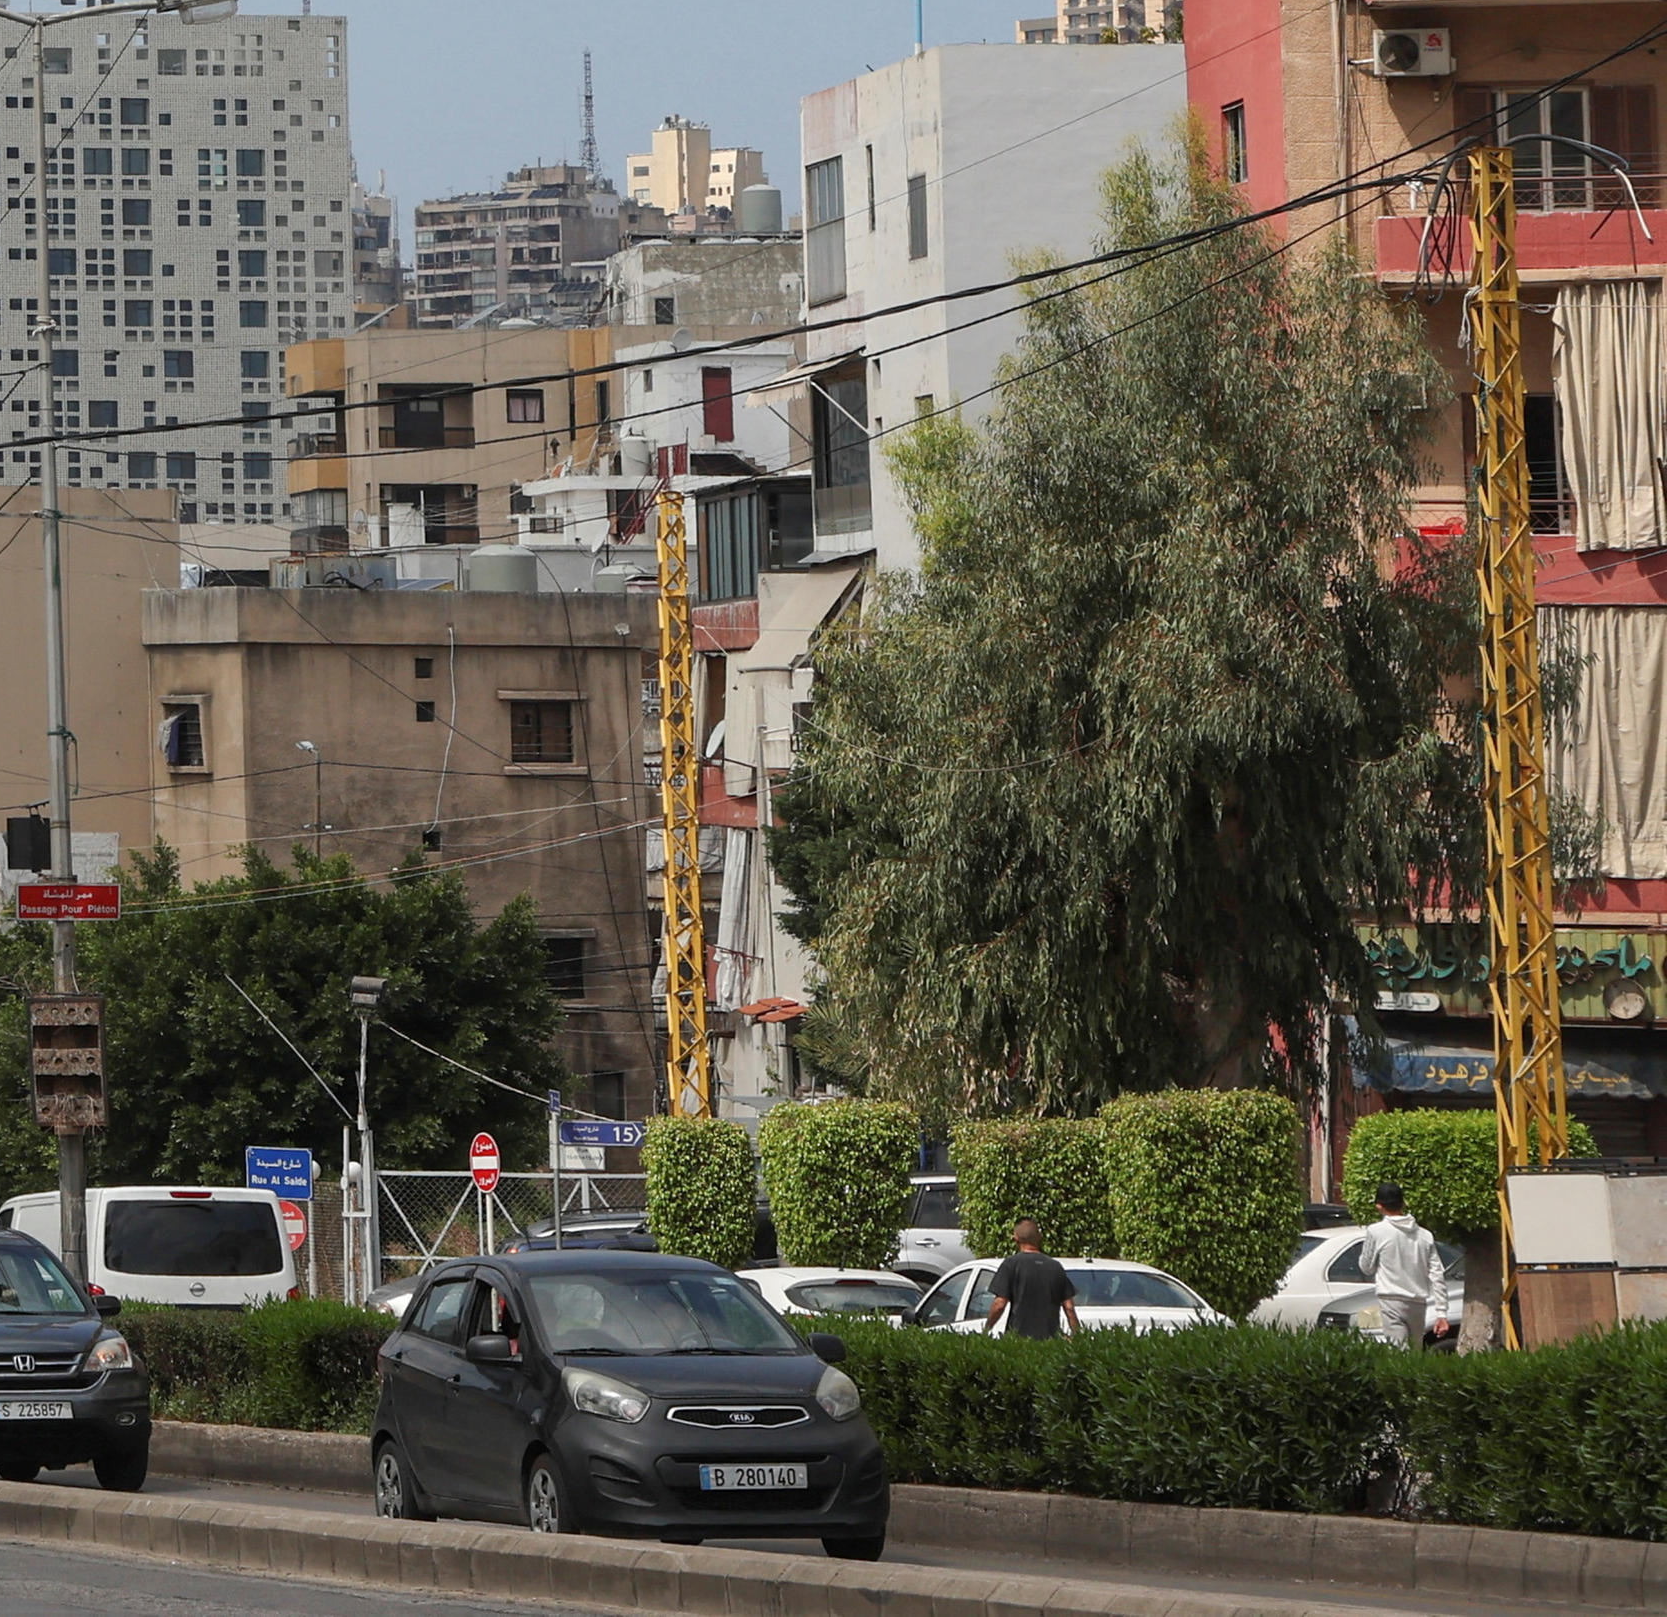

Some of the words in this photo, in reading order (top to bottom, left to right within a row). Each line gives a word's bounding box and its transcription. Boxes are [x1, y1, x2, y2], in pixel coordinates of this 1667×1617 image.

[20, 905, 57, 915] Passage
[61, 905, 83, 913] Pour
[613, 1126, 633, 1142] 15
[283, 1159, 302, 1170] شارع
[251, 1175, 267, 1184] Rue
[271, 1175, 280, 1185] Al
[3, 1404, 10, 1417] S
[18, 1403, 63, 1417] 225857
[733, 1413, 751, 1421] KIA
[715, 1469, 725, 1486] B
[736, 1468, 796, 1486] 280140
